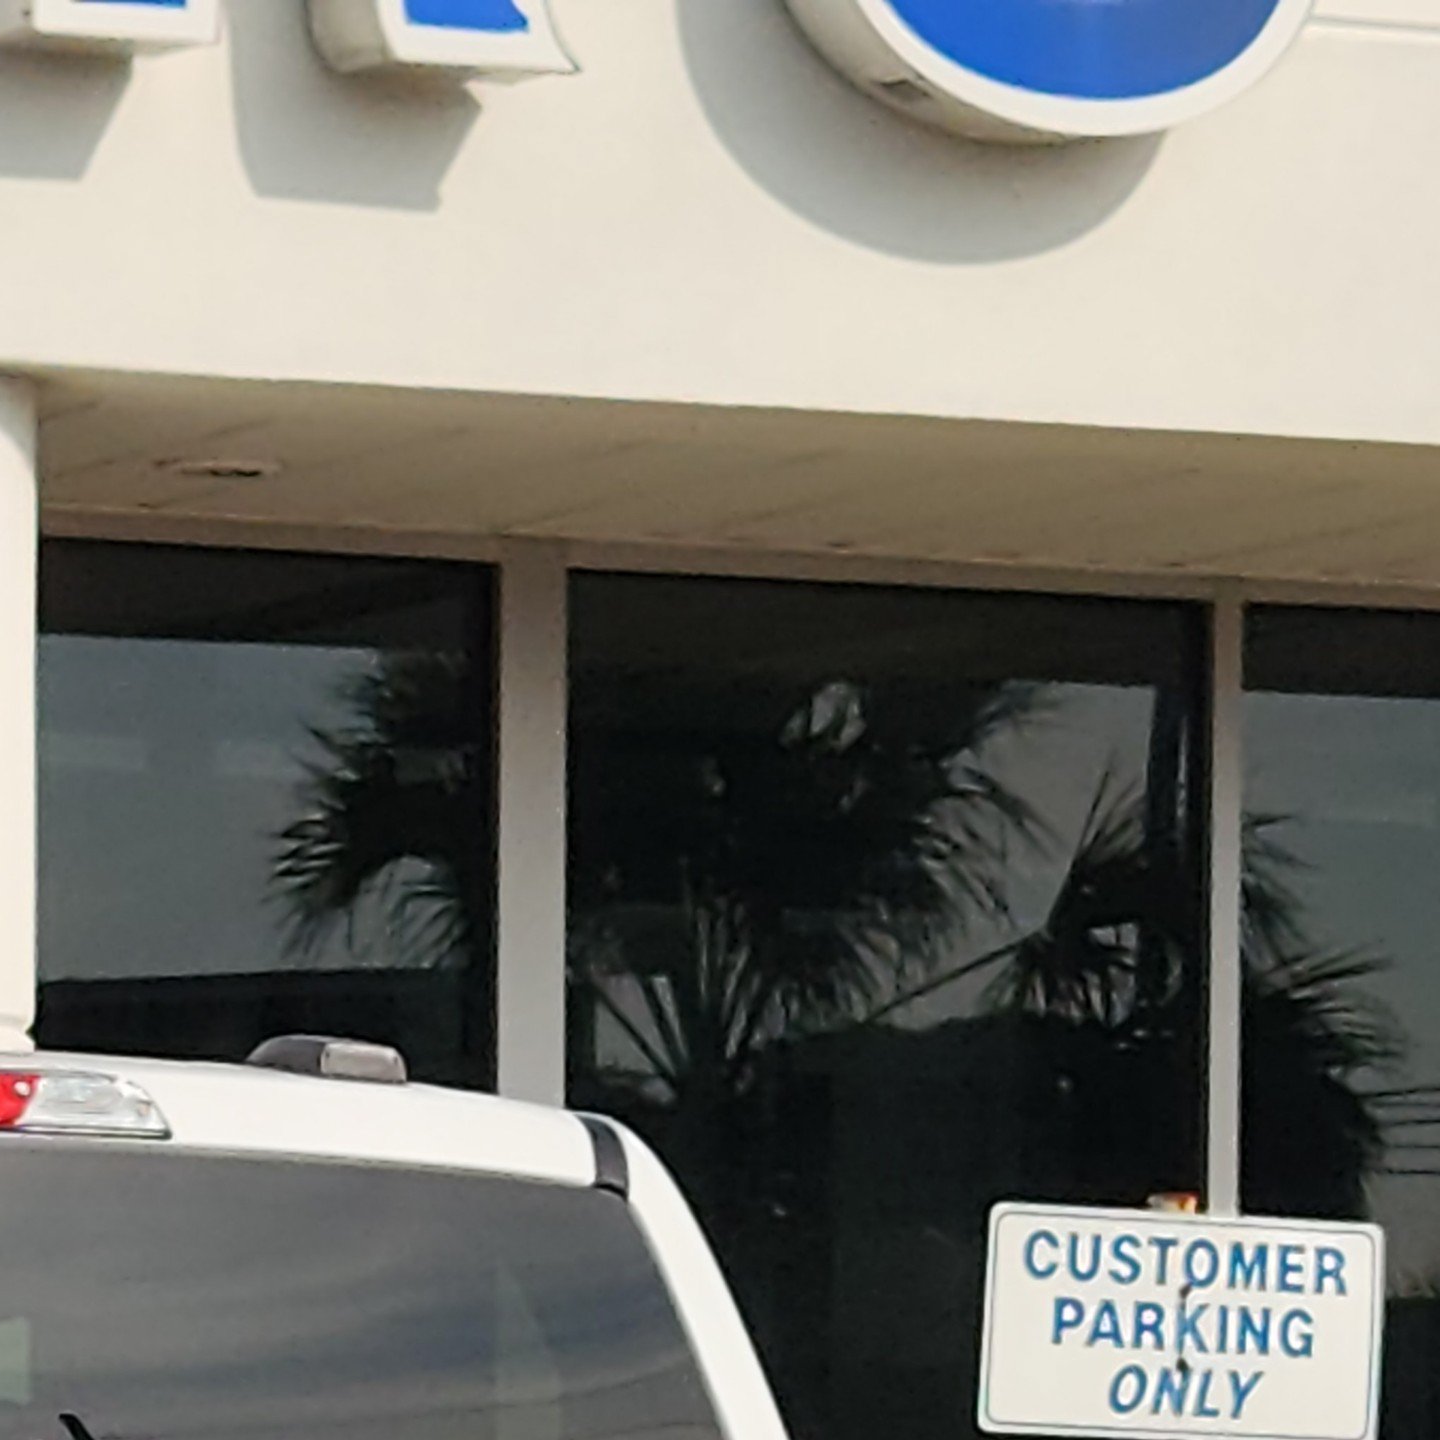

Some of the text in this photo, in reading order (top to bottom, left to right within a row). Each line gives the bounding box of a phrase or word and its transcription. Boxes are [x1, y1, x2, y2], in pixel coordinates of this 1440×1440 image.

[1024, 1230, 1348, 1295] CUSTOMER
[1051, 1297, 1313, 1358] PARKING
[1109, 1364, 1265, 1420] ONLY
